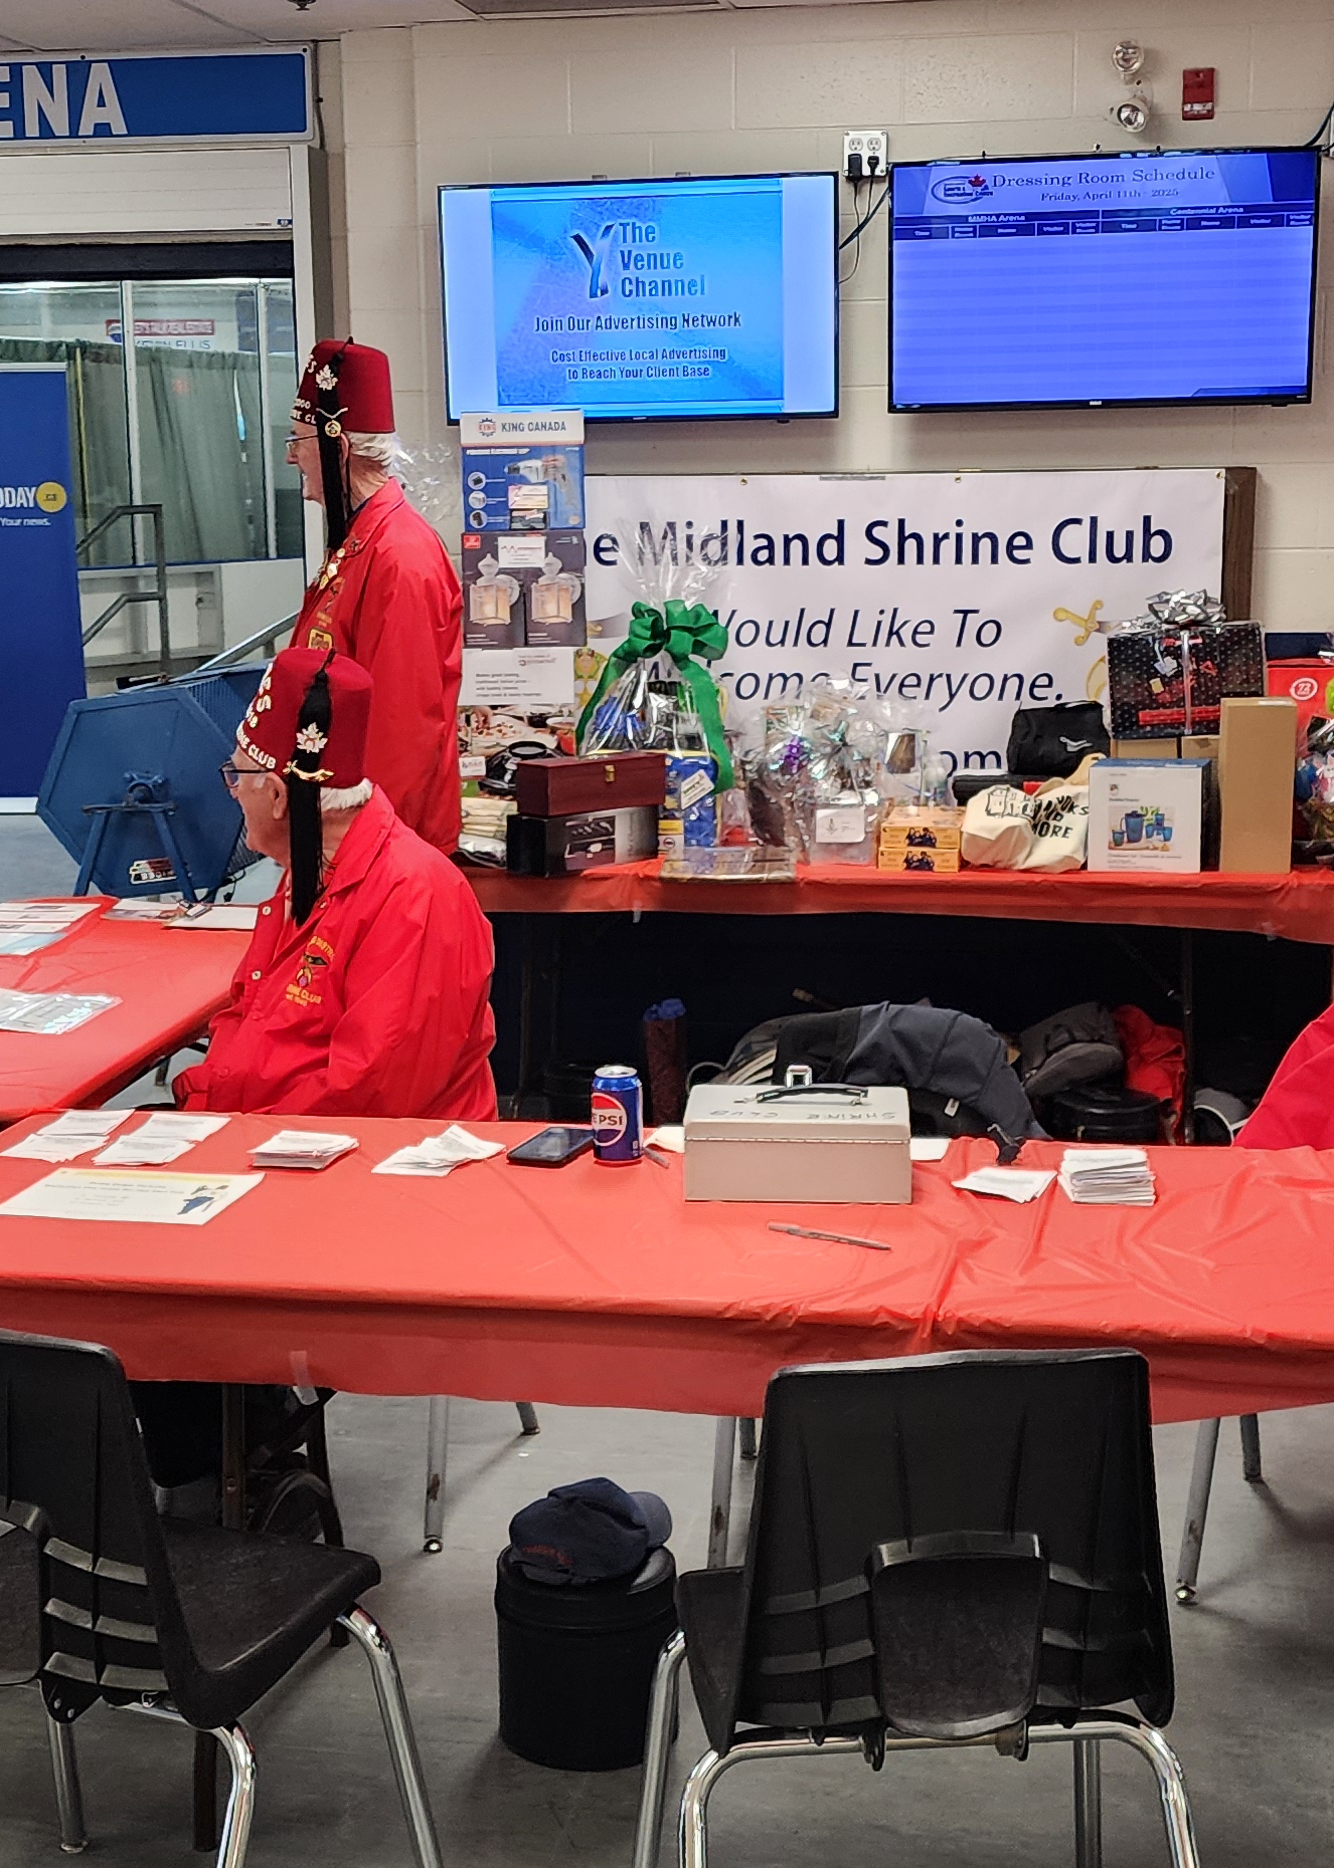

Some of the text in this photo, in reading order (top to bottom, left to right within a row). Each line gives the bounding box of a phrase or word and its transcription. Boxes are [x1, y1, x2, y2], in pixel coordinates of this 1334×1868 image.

[993, 166, 1216, 188] Dressing Room Schedule
[1041, 192, 1080, 202] Friday,
[1083, 189, 1113, 201] April
[1151, 188, 1179, 198] 2025
[998, 214, 1025, 222] Arena
[1170, 206, 1244, 216] Centennial Arena
[618, 221, 657, 244] The
[619, 249, 685, 272] Venue
[620, 274, 707, 299] Channel
[534, 311, 742, 333] Join Our Advertising Network
[550, 346, 727, 363] Cost Effective Local Advertising
[567, 364, 711, 381] to Reach Your Client Base
[501, 421, 567, 433] KING CANADA
[0, 516, 22, 528] Your
[23, 517, 51, 527] news.
[636, 514, 1174, 567] Midland Shrine Club
[846, 607, 936, 649] Like
[951, 608, 1003, 649] To
[248, 743, 277, 769] CLUB
[591, 1112, 624, 1127] EPSI
